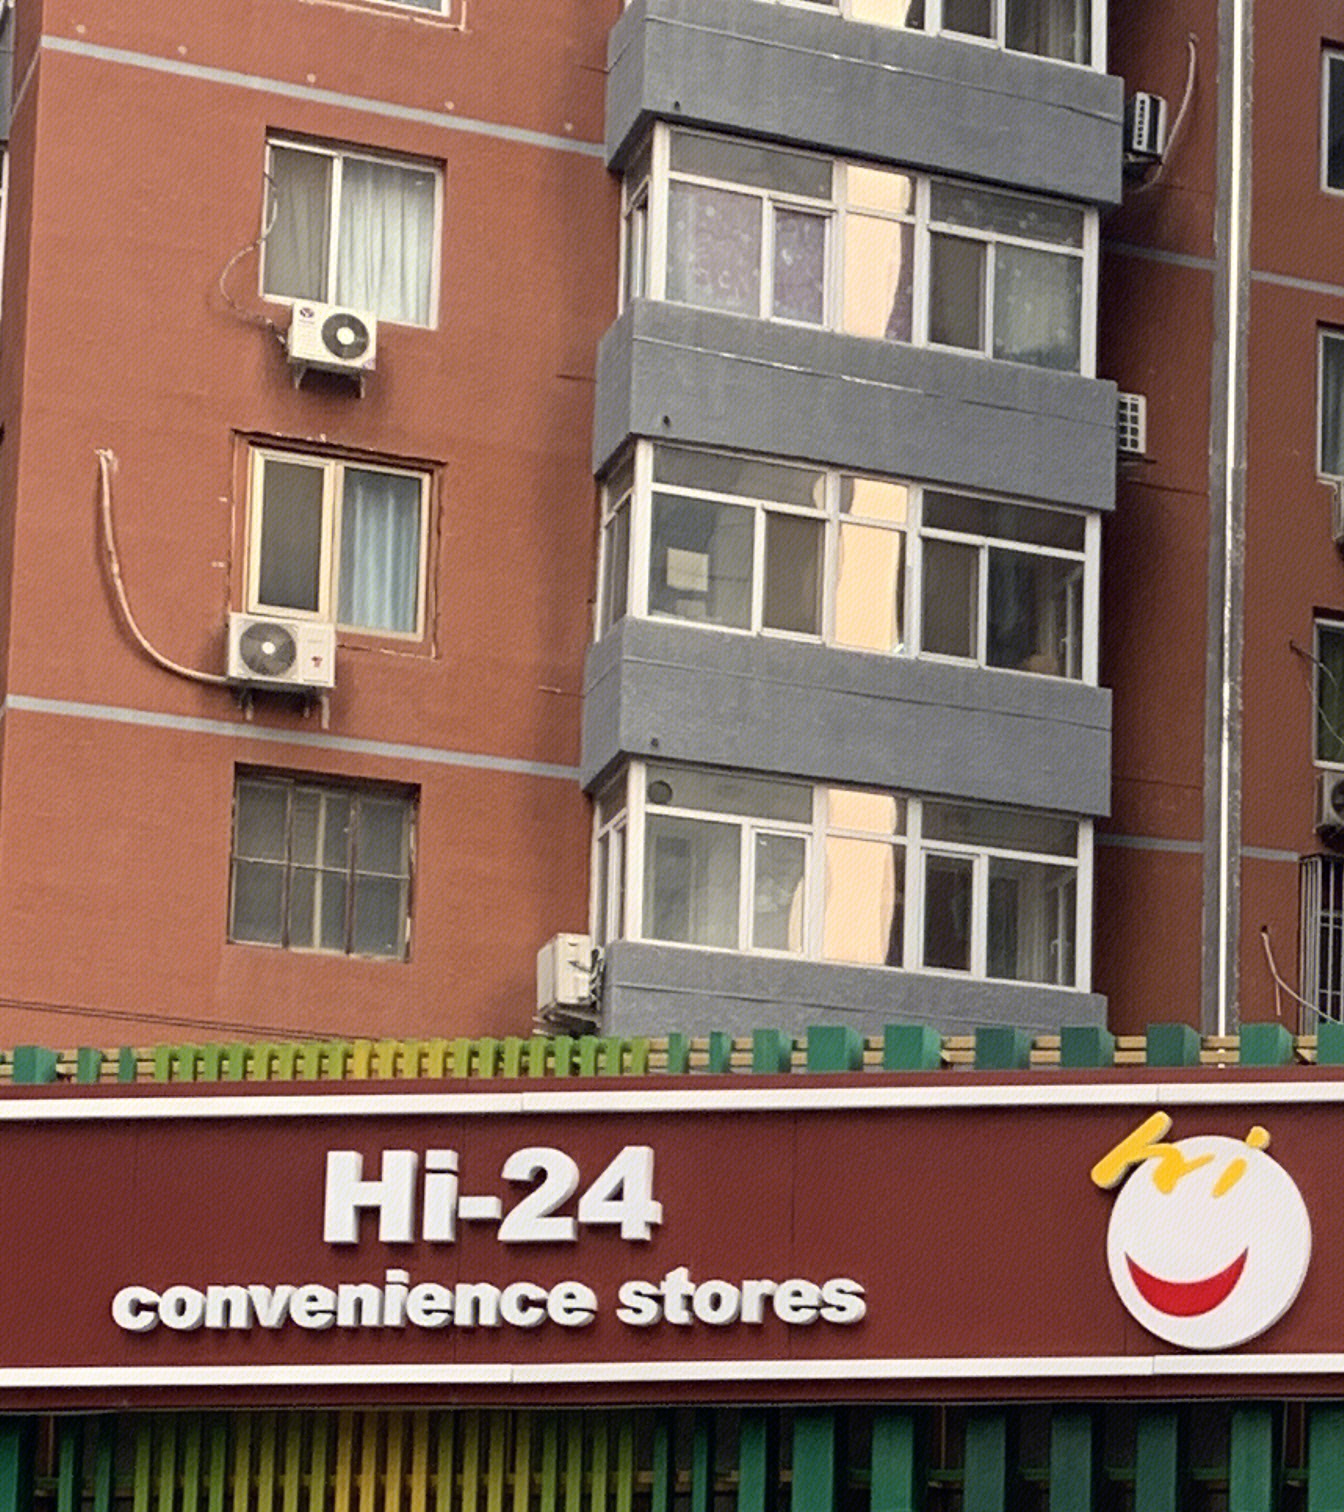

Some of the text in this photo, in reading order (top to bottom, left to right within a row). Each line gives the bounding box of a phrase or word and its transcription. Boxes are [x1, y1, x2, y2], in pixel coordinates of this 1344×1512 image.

[322, 1145, 664, 1244] Hi-24
[112, 1266, 867, 1331] convenience stores
